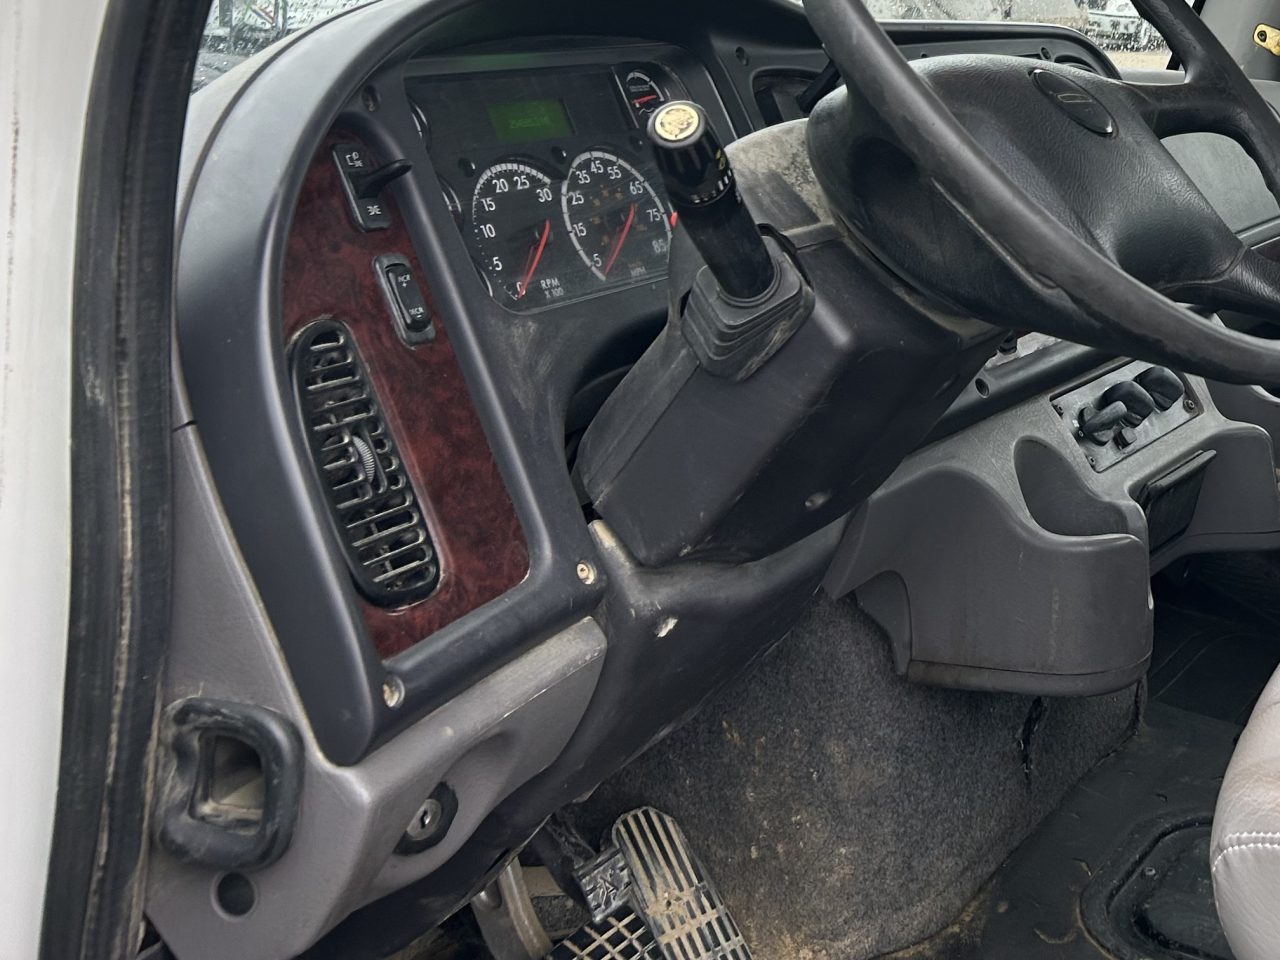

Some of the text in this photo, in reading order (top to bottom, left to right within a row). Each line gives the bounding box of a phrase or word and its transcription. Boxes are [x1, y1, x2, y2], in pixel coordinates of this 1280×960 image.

[590, 160, 604, 174] 45
[607, 165, 622, 180] 55
[513, 175, 530, 190] 25
[575, 170, 591, 184] 35
[492, 178, 509, 193] 20
[629, 181, 644, 195] 65
[536, 187, 553, 203] 30
[569, 191, 585, 206] 25
[480, 197, 496, 211] 15
[646, 208, 661, 222] 75
[480, 223, 496, 238] 10
[573, 222, 587, 237] 15
[651, 239, 668, 254] 85
[492, 256, 503, 271] 5
[593, 253, 602, 267] 5
[630, 266, 647, 278] MPH
[540, 278, 560, 290] RPM
[551, 287, 564, 298] 100
